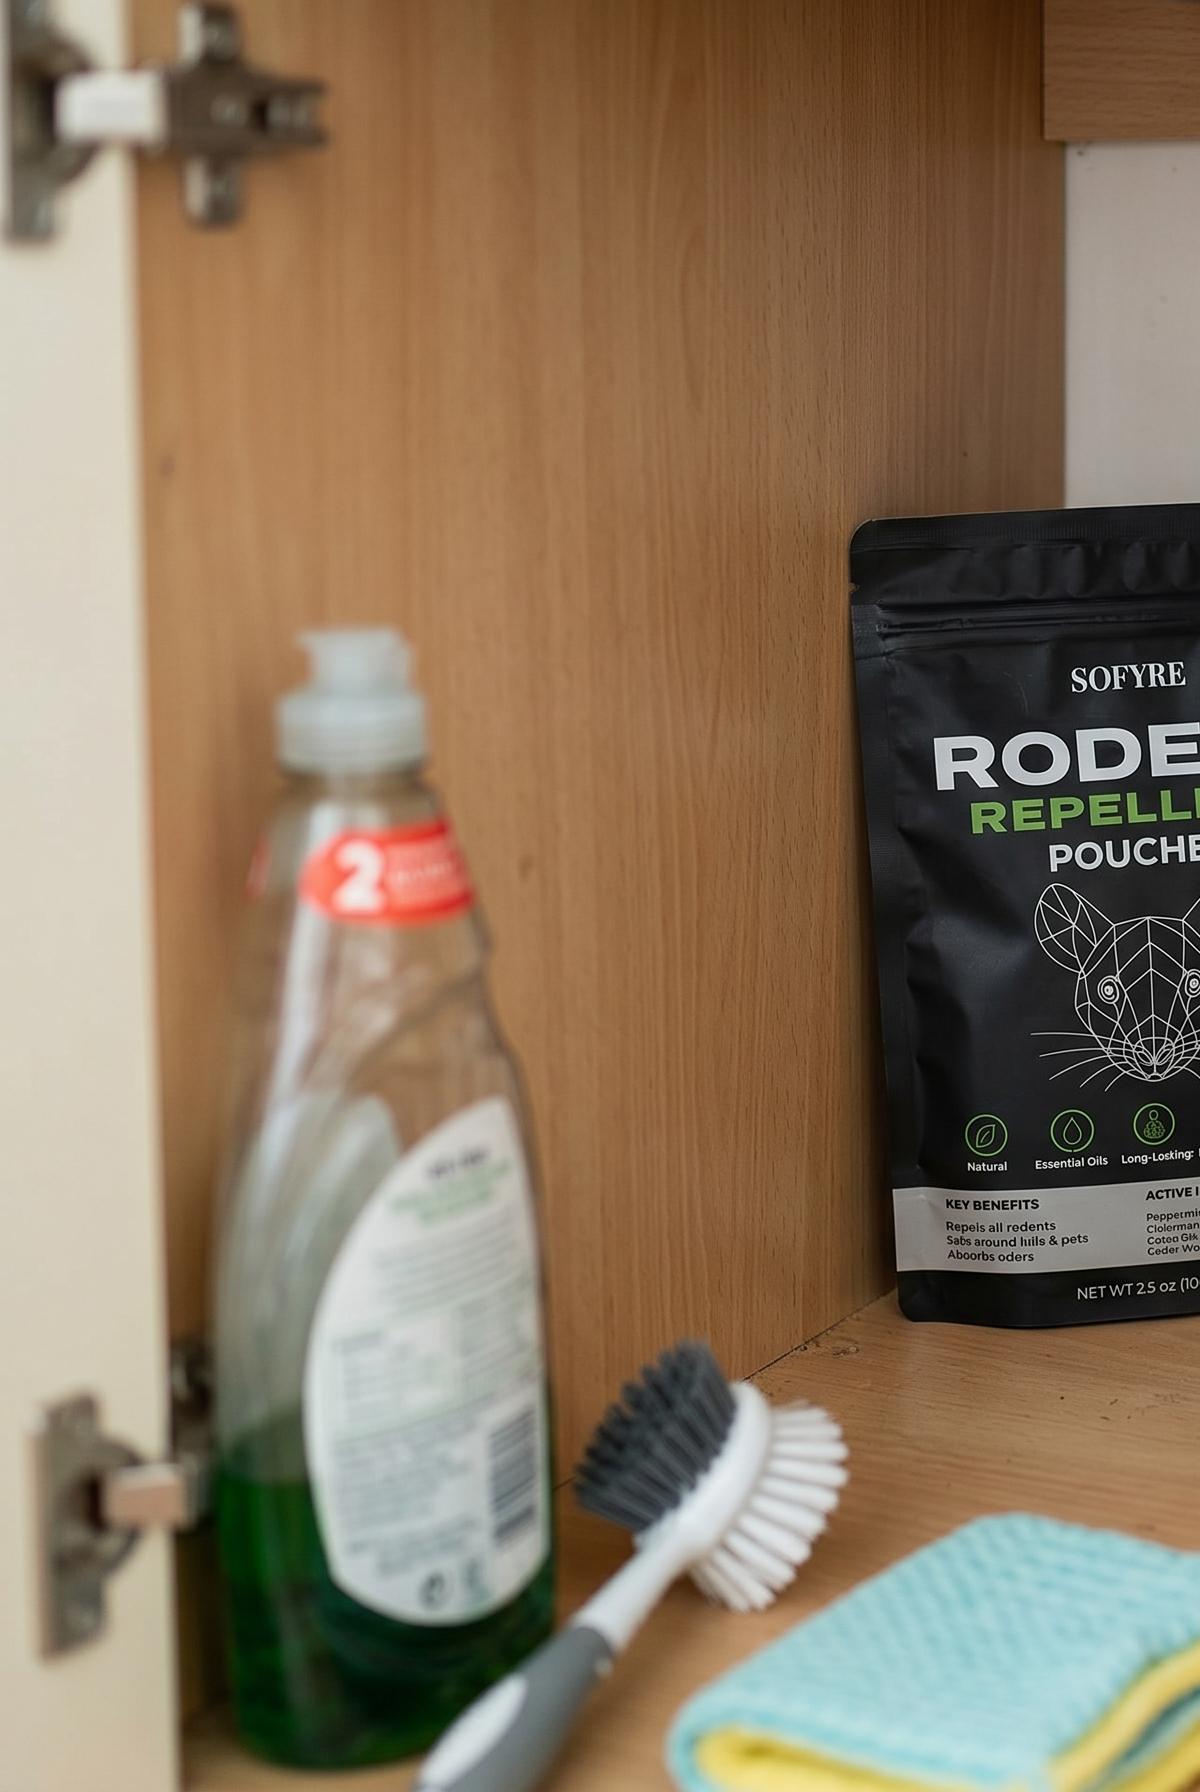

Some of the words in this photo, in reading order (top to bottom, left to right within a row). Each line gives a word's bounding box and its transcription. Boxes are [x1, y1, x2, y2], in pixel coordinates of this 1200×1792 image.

[1070, 660, 1187, 693] SOFYRE
[334, 838, 385, 914] 2
[967, 1161, 1008, 1172] Natural
[1035, 1157, 1085, 1170] Essential
[1087, 1155, 1109, 1167] Oils
[1145, 1186, 1193, 1201] ACTIVE
[945, 1199, 970, 1210] KEY
[973, 1199, 1040, 1211] BENEFITS
[988, 1222, 1004, 1233] all
[1006, 1221, 1057, 1233] redents
[974, 1237, 1017, 1247] around
[1048, 1235, 1058, 1246] &
[1061, 1234, 1089, 1247] pets
[997, 1251, 1035, 1262] oders
[1077, 1286, 1107, 1300] NET
[1109, 1283, 1133, 1297] WT
[1159, 1281, 1177, 1292] oz
